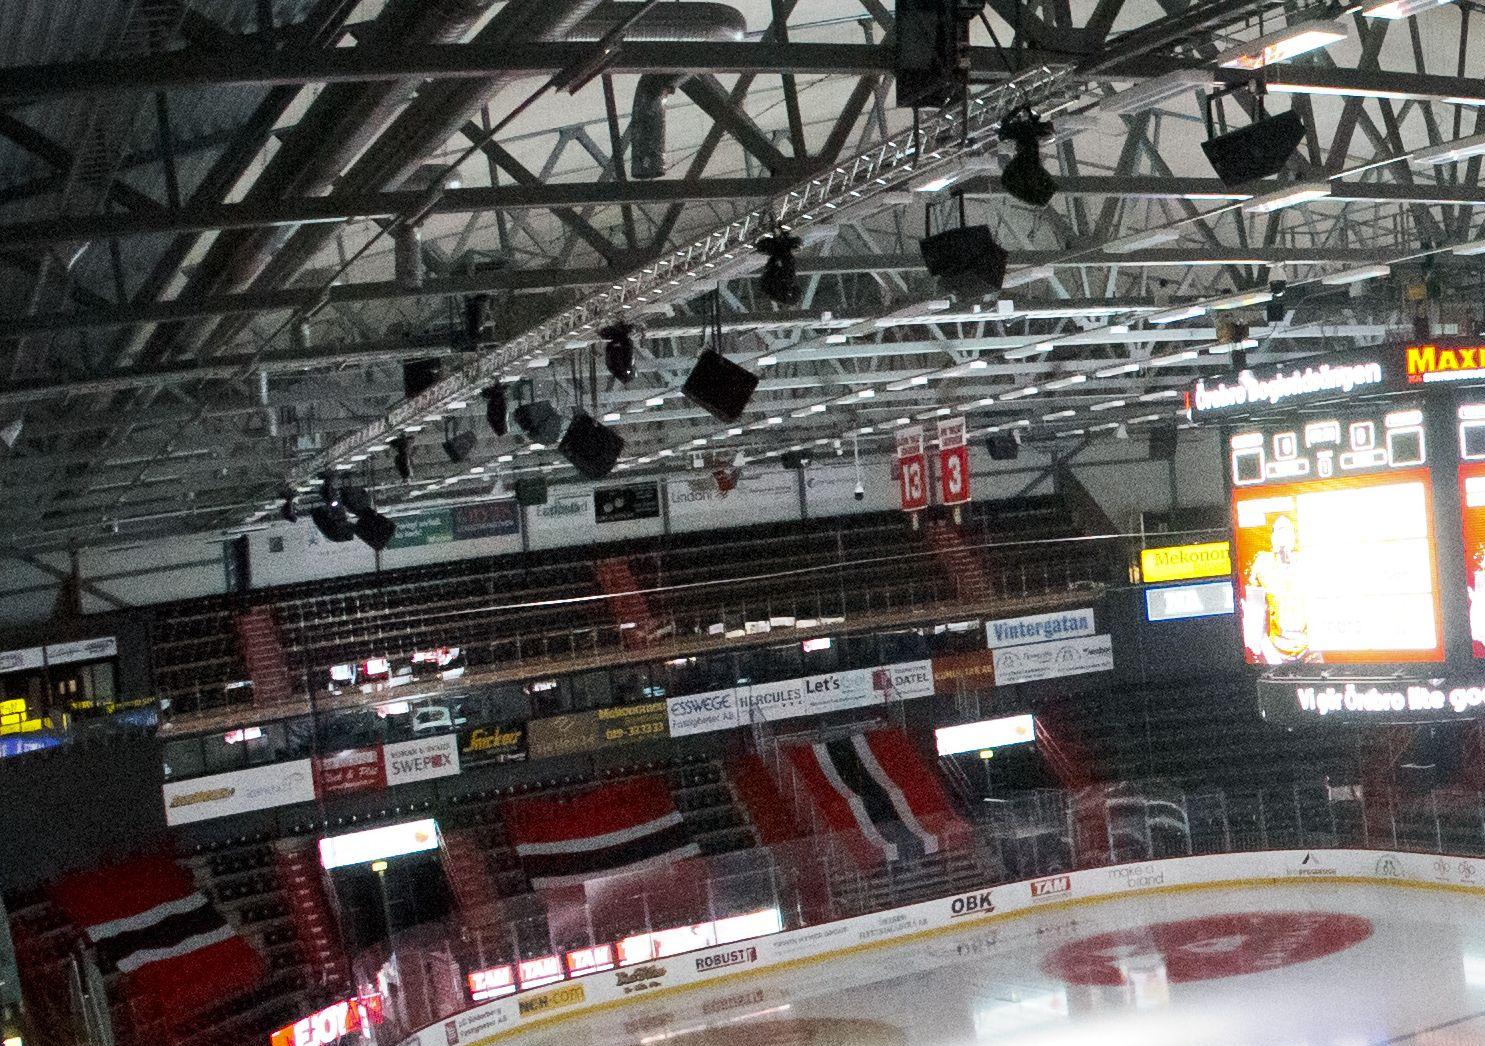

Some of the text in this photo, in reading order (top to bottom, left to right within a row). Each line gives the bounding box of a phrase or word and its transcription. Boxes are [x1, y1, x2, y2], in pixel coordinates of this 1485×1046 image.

[902, 462, 922, 501] 13
[947, 455, 962, 494] 3
[993, 615, 1089, 641] Vintergatan
[805, 675, 841, 695] Let's
[895, 672, 930, 687] DATEL
[671, 694, 731, 717] ESSWEGE
[740, 688, 801, 708] HERCULES
[1297, 687, 1316, 711] Vi
[1407, 687, 1446, 711] lite
[1034, 877, 1070, 894] TAM
[950, 892, 993, 914] OBK
[695, 949, 745, 970] ROBUST
